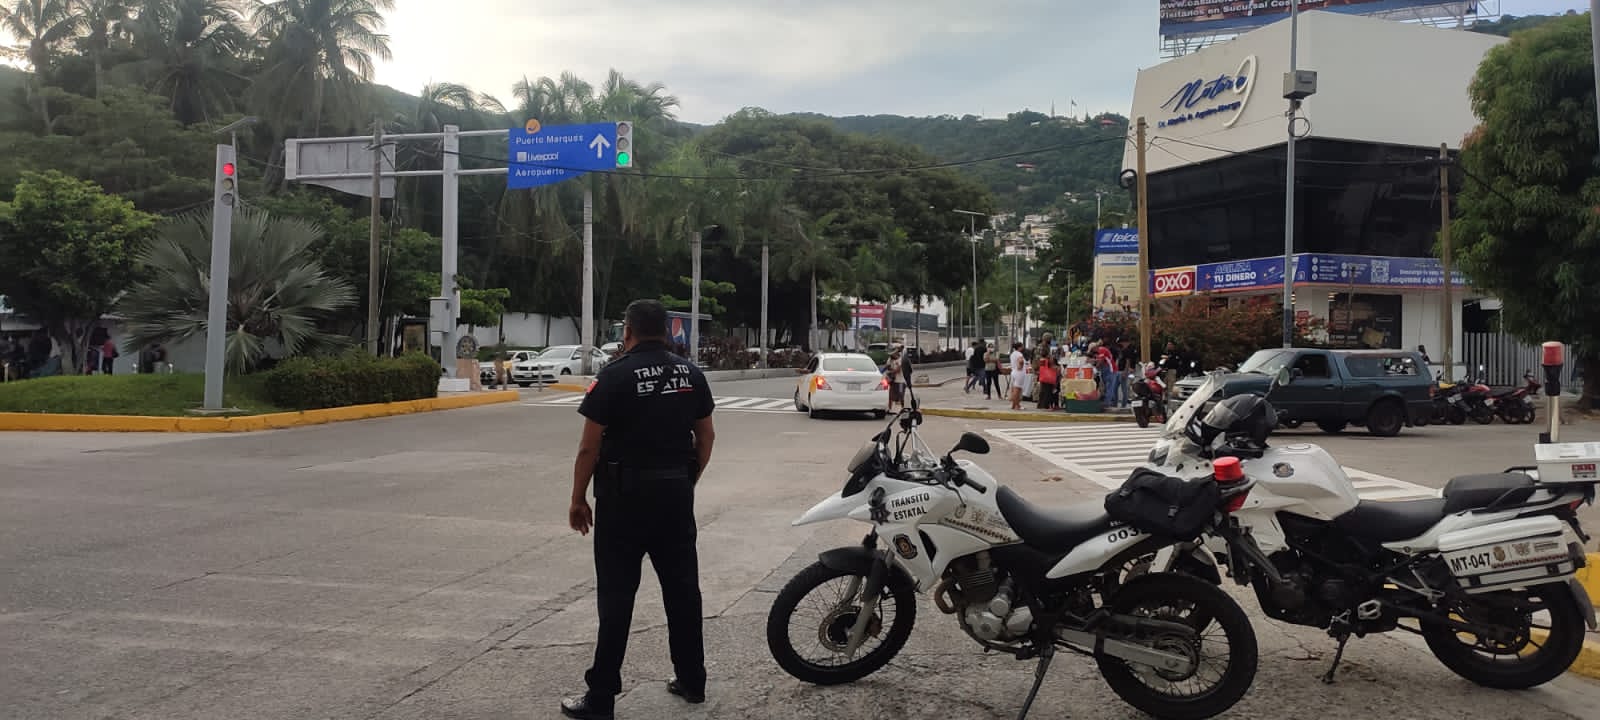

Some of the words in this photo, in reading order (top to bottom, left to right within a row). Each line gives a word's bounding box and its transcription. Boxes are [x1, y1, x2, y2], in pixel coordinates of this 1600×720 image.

[1207, 7, 1220, 15] en
[515, 136, 544, 145] Puerto
[527, 151, 559, 162] Liverpool
[515, 168, 565, 178] Aeropuerto
[1111, 232, 1139, 242] telce
[1155, 272, 1190, 293] OXXO
[1213, 275, 1224, 283] TU
[1225, 271, 1257, 282] DINERO
[634, 364, 690, 379] TRANTO
[637, 377, 692, 393] ESATAL
[894, 506, 928, 521] ESTATAL
[1450, 552, 1490, 573] MT-047
